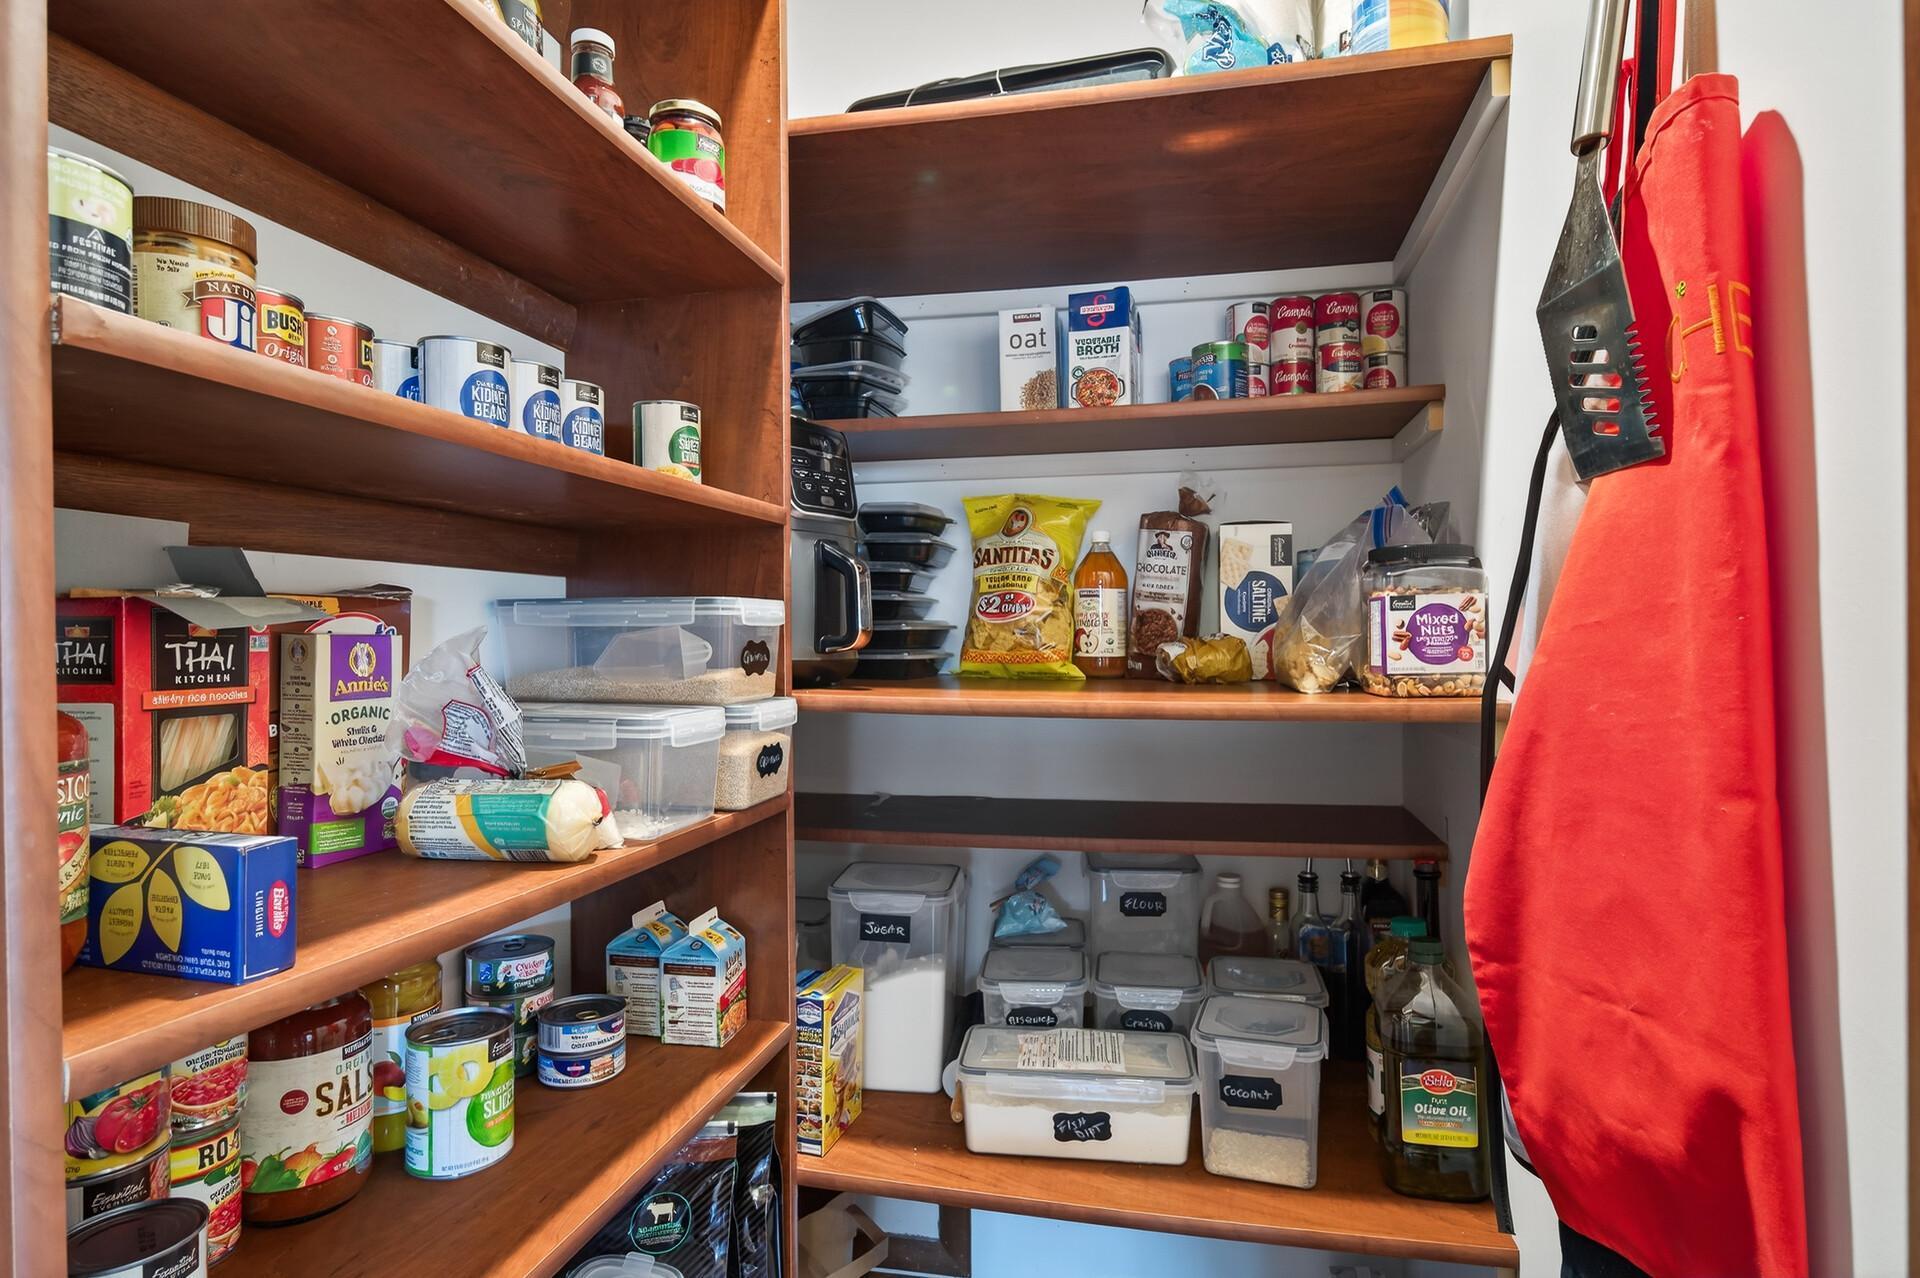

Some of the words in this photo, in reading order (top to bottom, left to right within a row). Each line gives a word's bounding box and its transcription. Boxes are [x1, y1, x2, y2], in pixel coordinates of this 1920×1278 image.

[1009, 327, 1048, 350] oat
[1074, 334, 1121, 346] VEGETABLE
[1076, 342, 1119, 357] BROTH
[474, 401, 507, 422] BEANS
[973, 545, 1056, 570] SANTITAS
[1136, 562, 1188, 576] CHOCOLATE
[1251, 579, 1267, 624] SALTINE
[1415, 613, 1459, 626] Mixed
[1420, 625, 1455, 637] Nuts
[164, 641, 236, 673] THAI
[174, 673, 232, 685] KITCHEN
[334, 675, 389, 697] Annie's
[187, 692, 207, 704] rice
[208, 690, 249, 702] noodles
[331, 705, 391, 725] ORGANIC
[1125, 897, 1165, 912] FLOUR
[255, 889, 264, 938] LINGUINE
[1414, 1103, 1447, 1115] Olive
[1449, 1106, 1468, 1117] Oil
[91, 1177, 145, 1208] Essential
